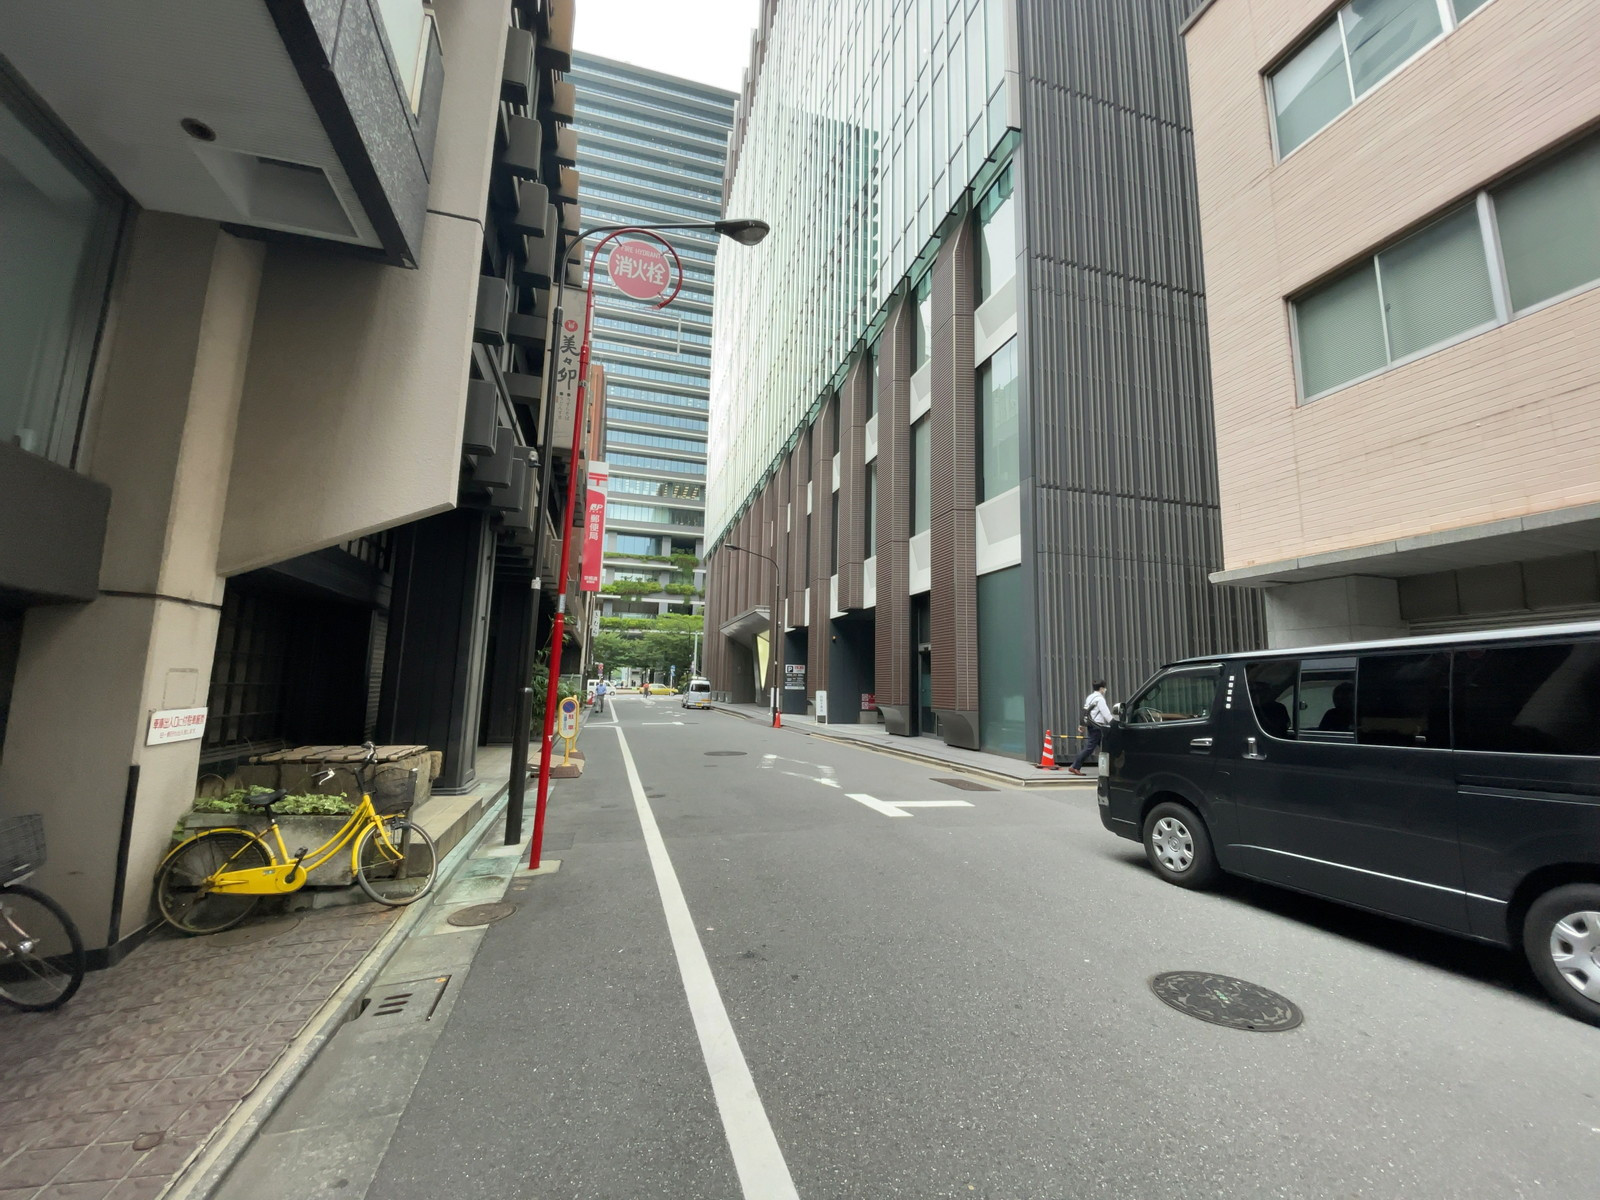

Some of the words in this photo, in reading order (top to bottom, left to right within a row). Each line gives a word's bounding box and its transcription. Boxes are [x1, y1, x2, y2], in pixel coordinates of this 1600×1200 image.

[614, 254, 666, 286] 消火栓
[557, 334, 580, 390] 美々卯
[589, 514, 600, 540] 郵便局
